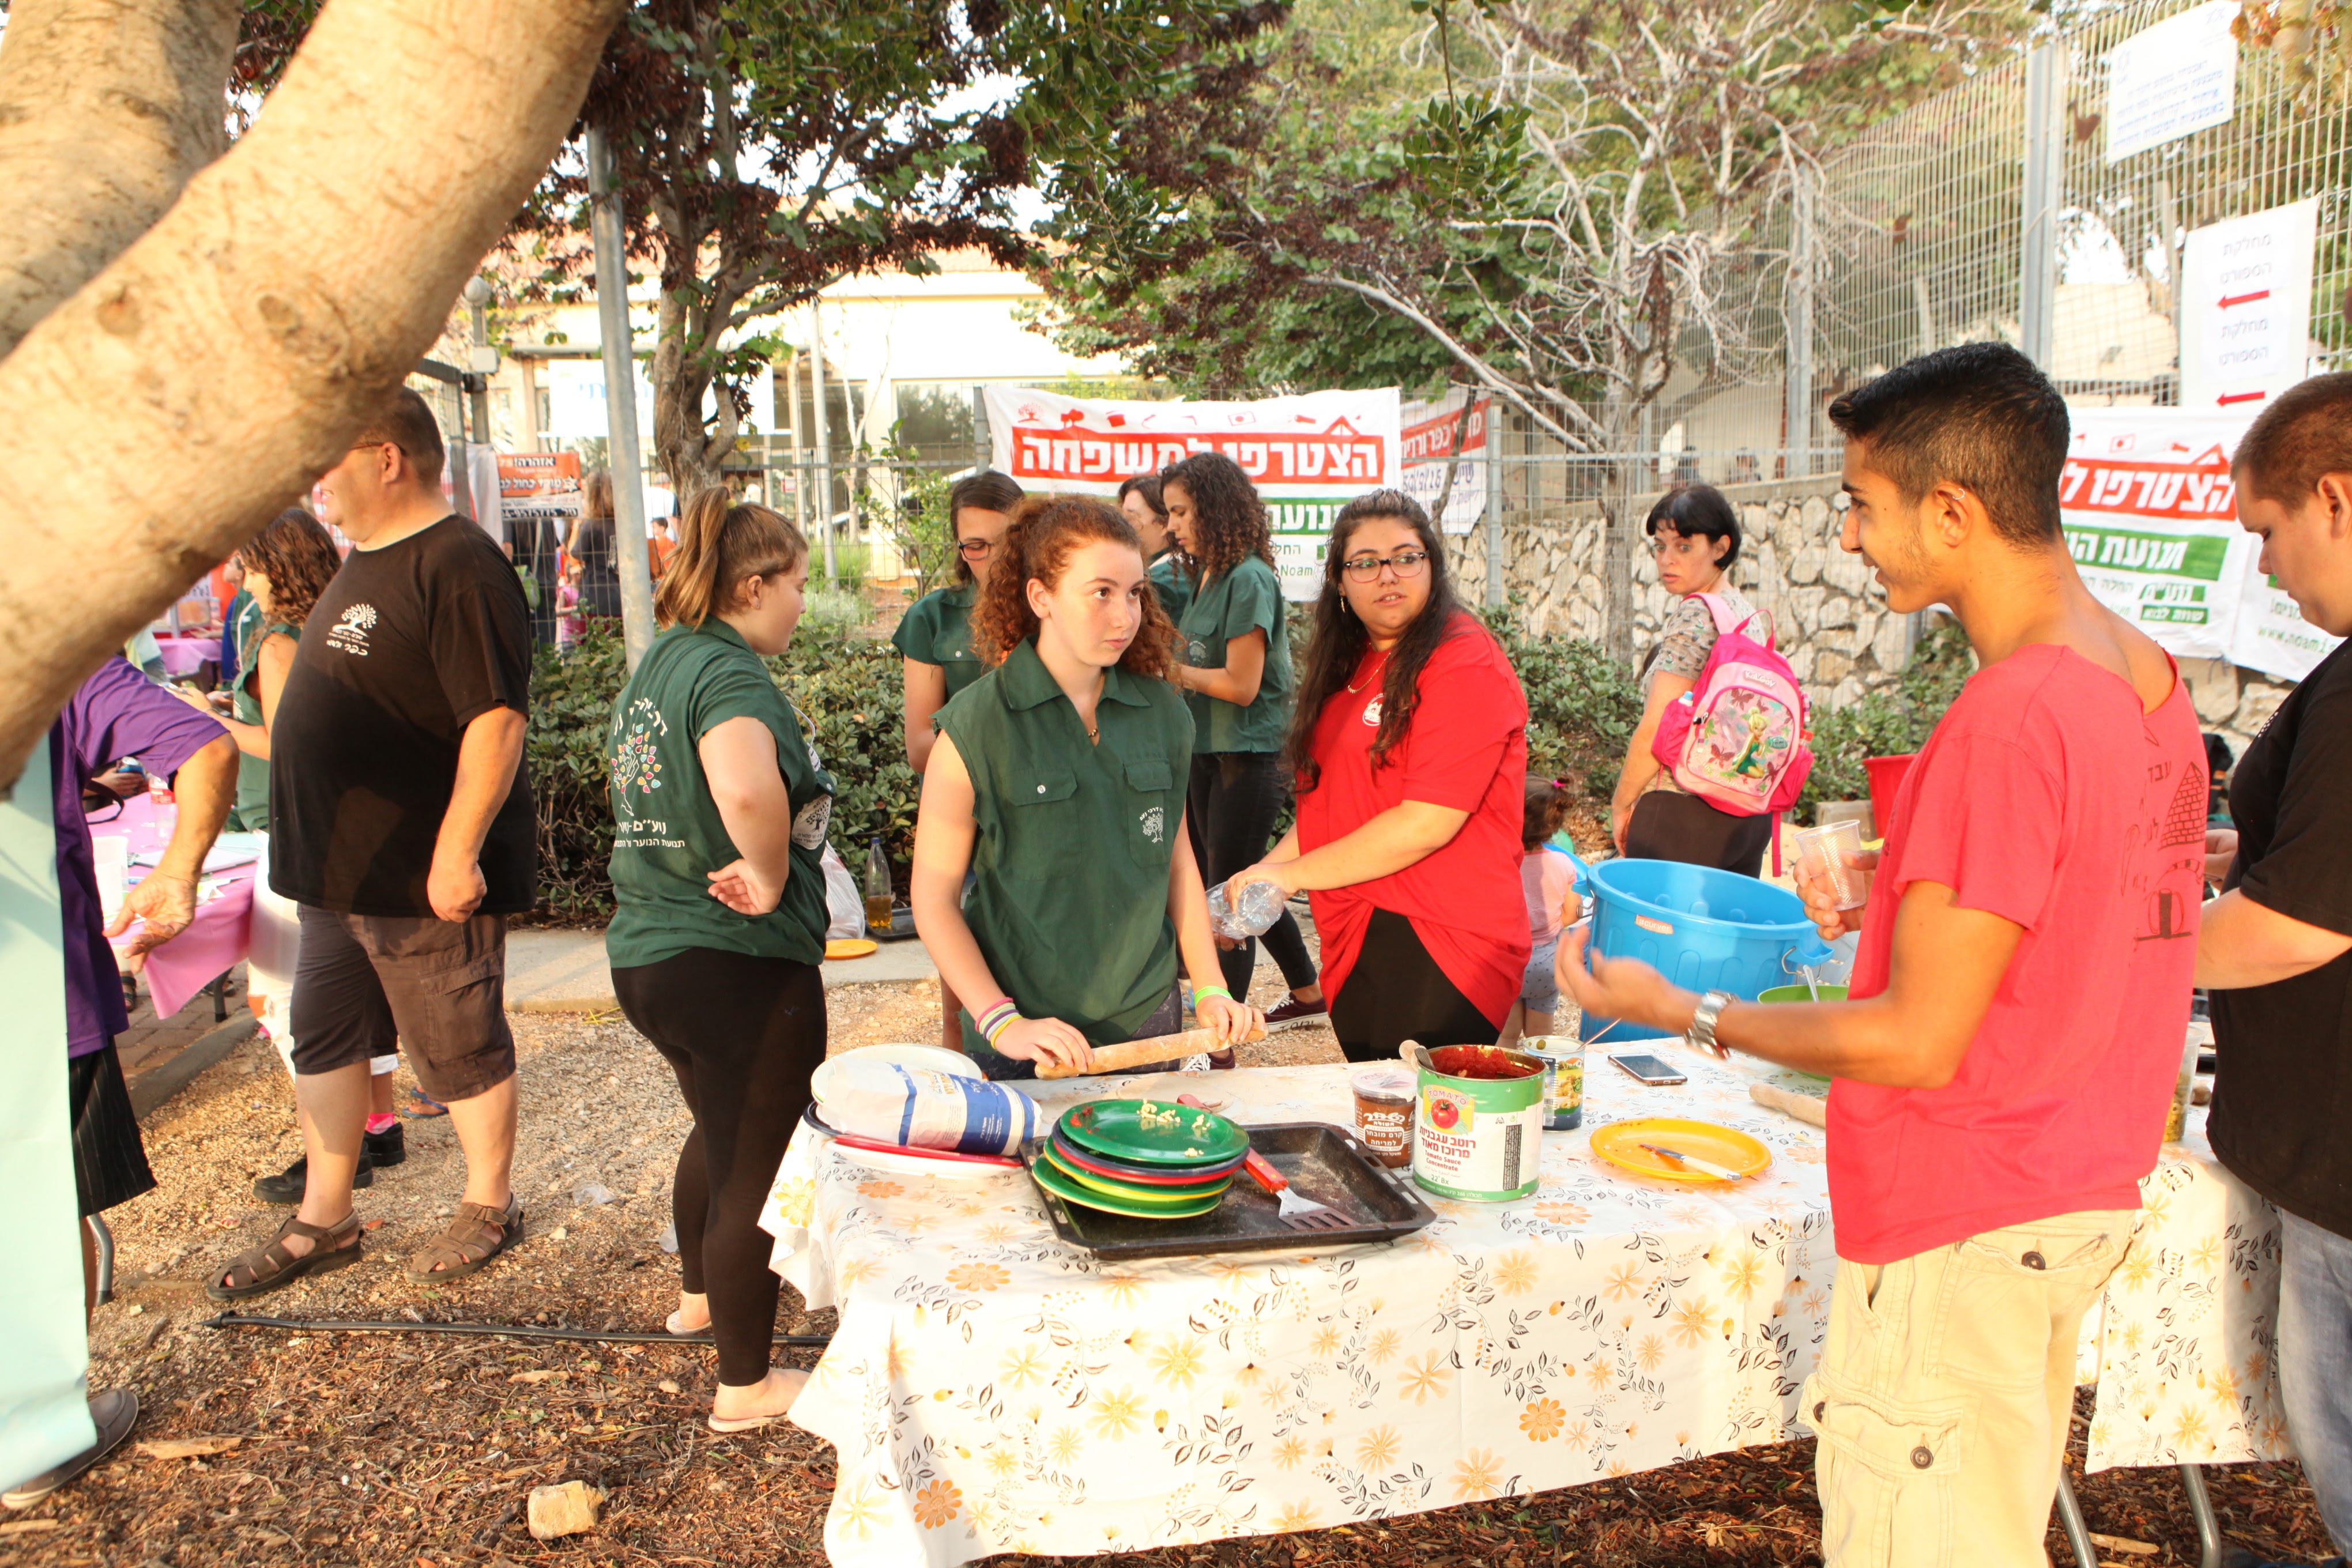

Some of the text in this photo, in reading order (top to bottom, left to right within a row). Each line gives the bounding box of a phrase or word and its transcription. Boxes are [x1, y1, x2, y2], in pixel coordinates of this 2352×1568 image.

[2088, 468, 2236, 513] הצטרפו
[2098, 535, 2189, 570] תנועת
[1280, 564, 1313, 576] Noam
[632, 838, 660, 847] הנוער
[662, 839, 685, 848] תנועת
[1644, 921, 1670, 932] curver
[1428, 1089, 1468, 1105] TOMATO
[1420, 1125, 1448, 1144] עגבניות
[1422, 1137, 1470, 1158] מרוכז מאוד
[1450, 1136, 1476, 1149] רוטב
[1425, 1149, 1461, 1165] Tomato Sauce
[1426, 1158, 1458, 1171] Concentrate
